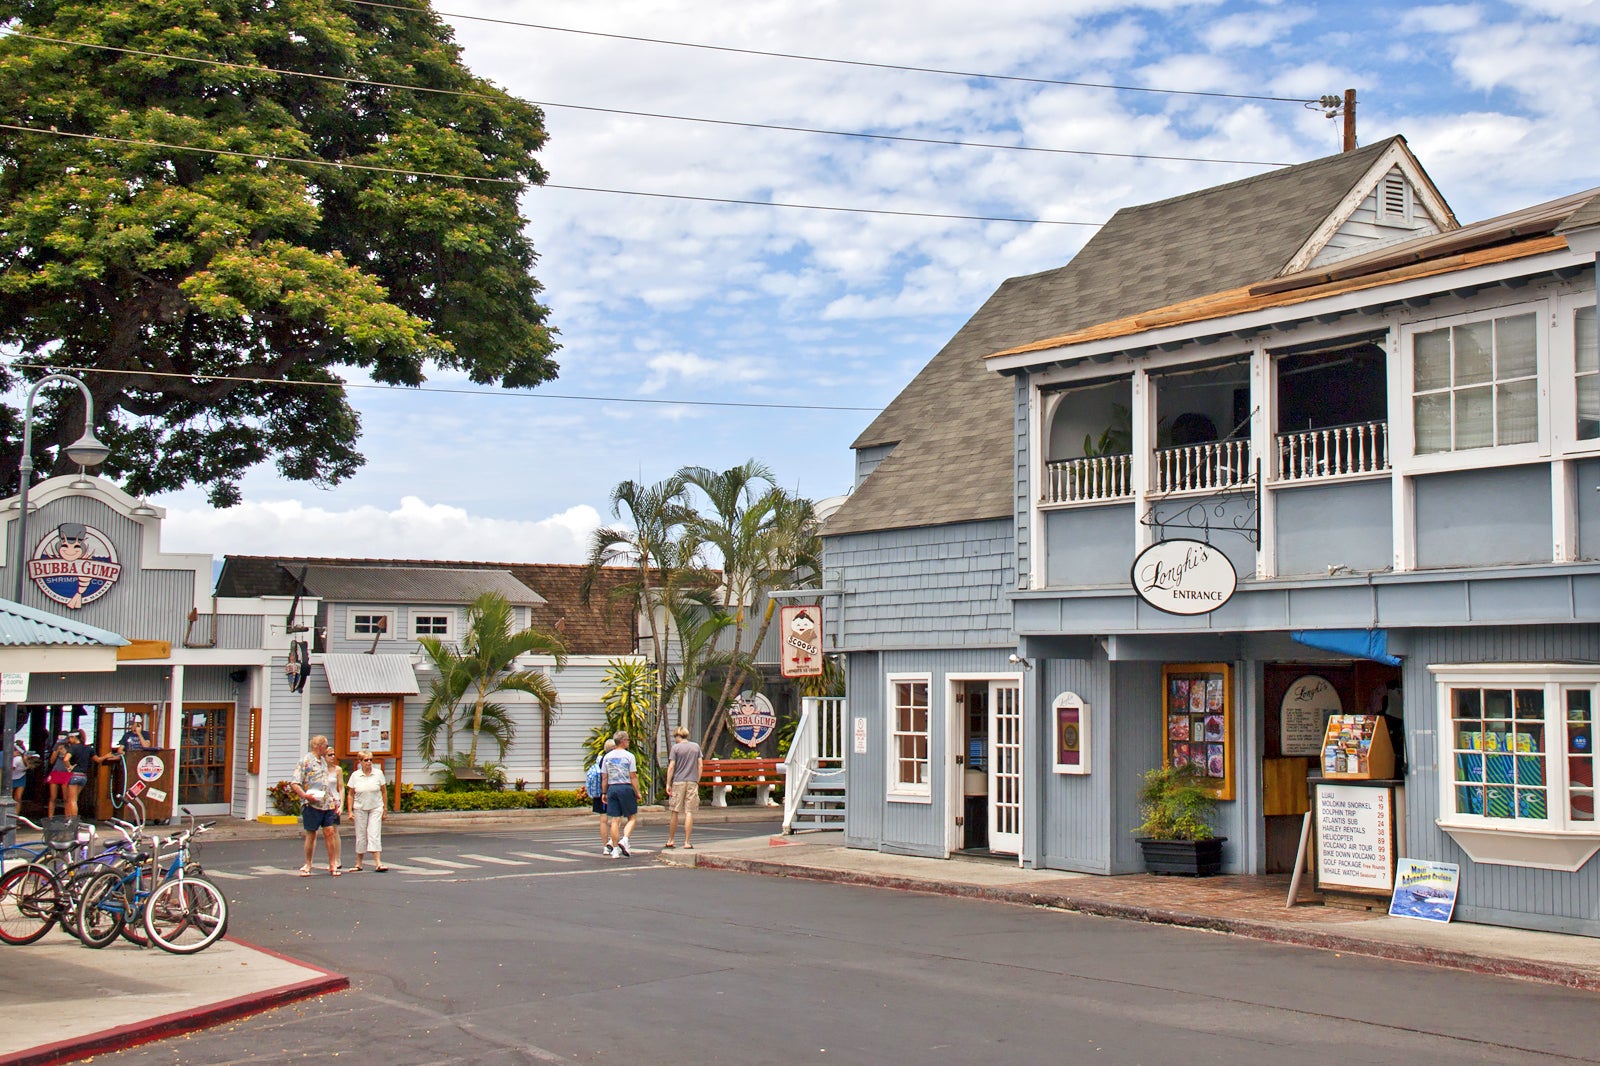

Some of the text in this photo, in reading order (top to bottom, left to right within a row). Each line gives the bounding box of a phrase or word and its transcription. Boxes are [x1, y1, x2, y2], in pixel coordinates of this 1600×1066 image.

[33, 560, 118, 578] BUBBA GUMP
[1141, 546, 1209, 592] Longhi's
[46, 576, 78, 584] SHRIMP
[1173, 590, 1223, 601] ENTRANCE
[788, 636, 817, 654] SCOOPS
[1347, 802, 1372, 810] SNORKEL
[1322, 808, 1344, 816] DOLPHIN
[1322, 816, 1346, 824] ATLANTIS
[1343, 826, 1366, 834] RENTALS
[1323, 833, 1354, 841] HELICOPTER
[1323, 841, 1347, 849] VOLCANO
[1358, 844, 1373, 852] TOUR
[1351, 852, 1376, 861] VOLCANO
[1323, 858, 1337, 866] GOLF
[1338, 859, 1362, 868] PACKAGE
[1324, 867, 1341, 875] WHALE
[1342, 869, 1360, 877] WATCH
[1411, 864, 1427, 873] Maui
